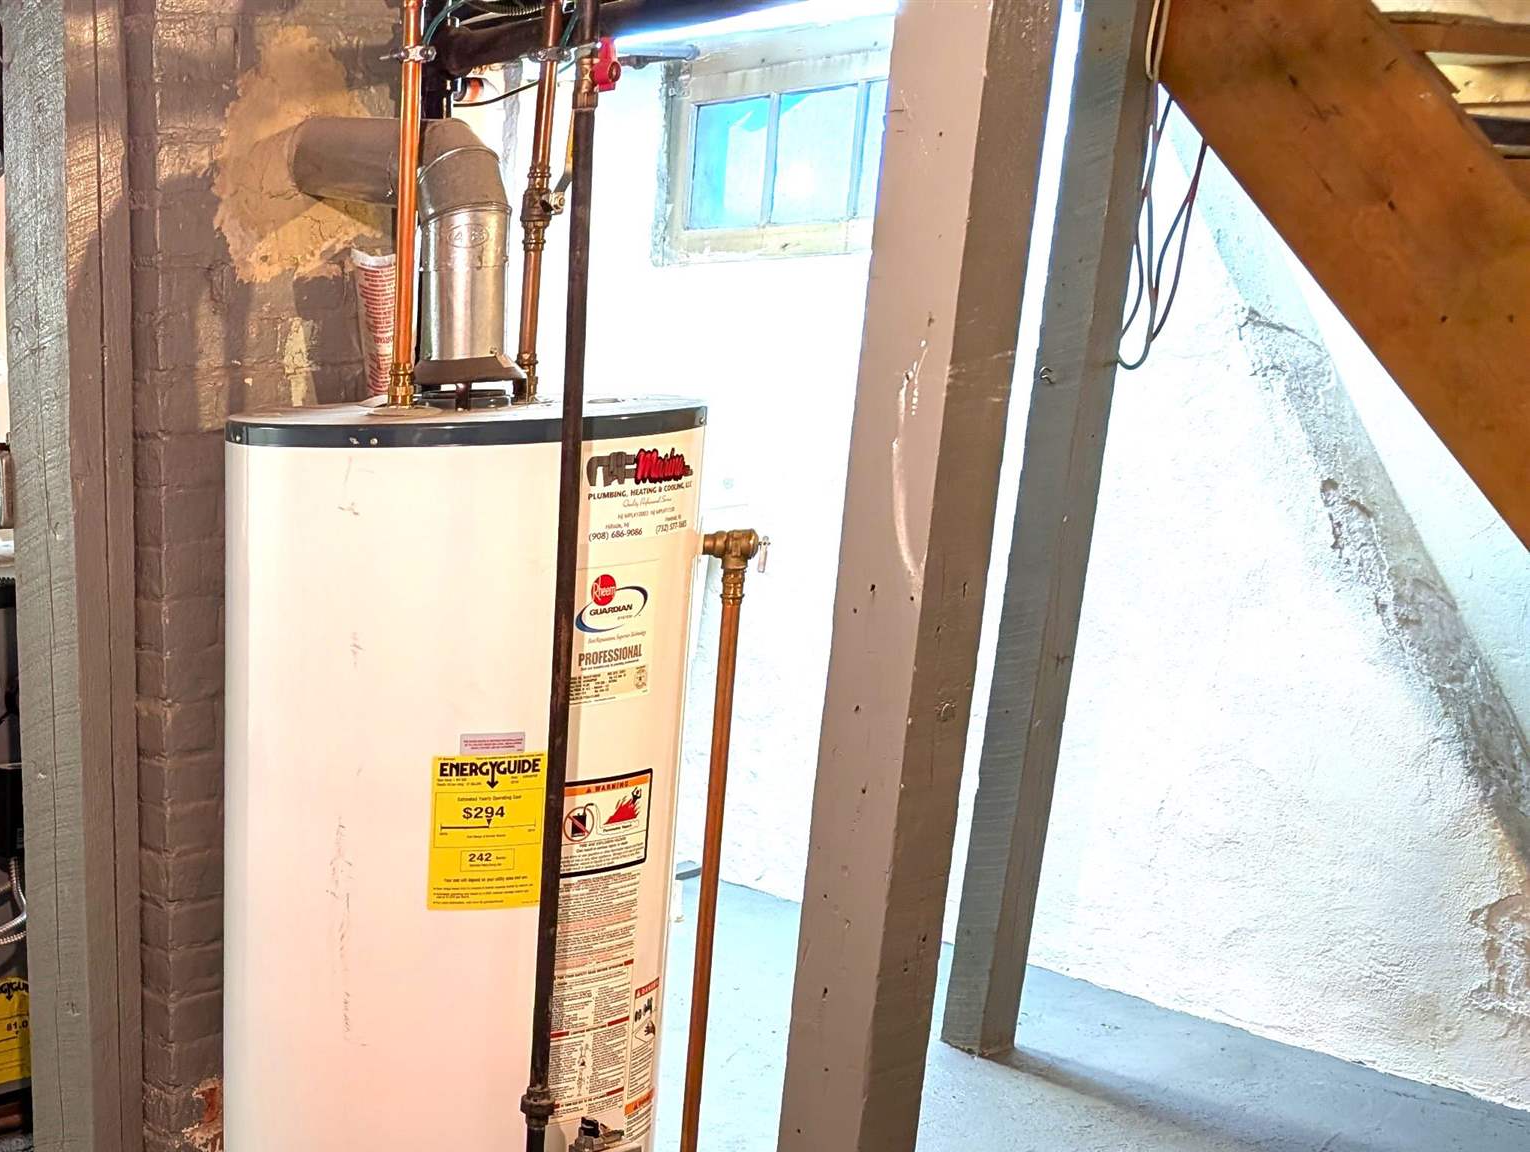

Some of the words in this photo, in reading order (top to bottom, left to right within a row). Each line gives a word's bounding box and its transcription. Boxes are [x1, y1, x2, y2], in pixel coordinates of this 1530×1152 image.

[587, 490, 628, 501] PLUMBING,
[630, 486, 657, 497] HEATING
[588, 531, 609, 542] (908)
[611, 527, 643, 539] 686-9086
[591, 577, 616, 601] Rheem
[589, 604, 633, 616] GUARDIAN
[578, 643, 642, 667] PROFESSIONAL
[439, 758, 541, 779] ENERGYGUIDE
[595, 781, 629, 792] WARNING
[462, 806, 505, 819] $294
[468, 852, 492, 862] 242
